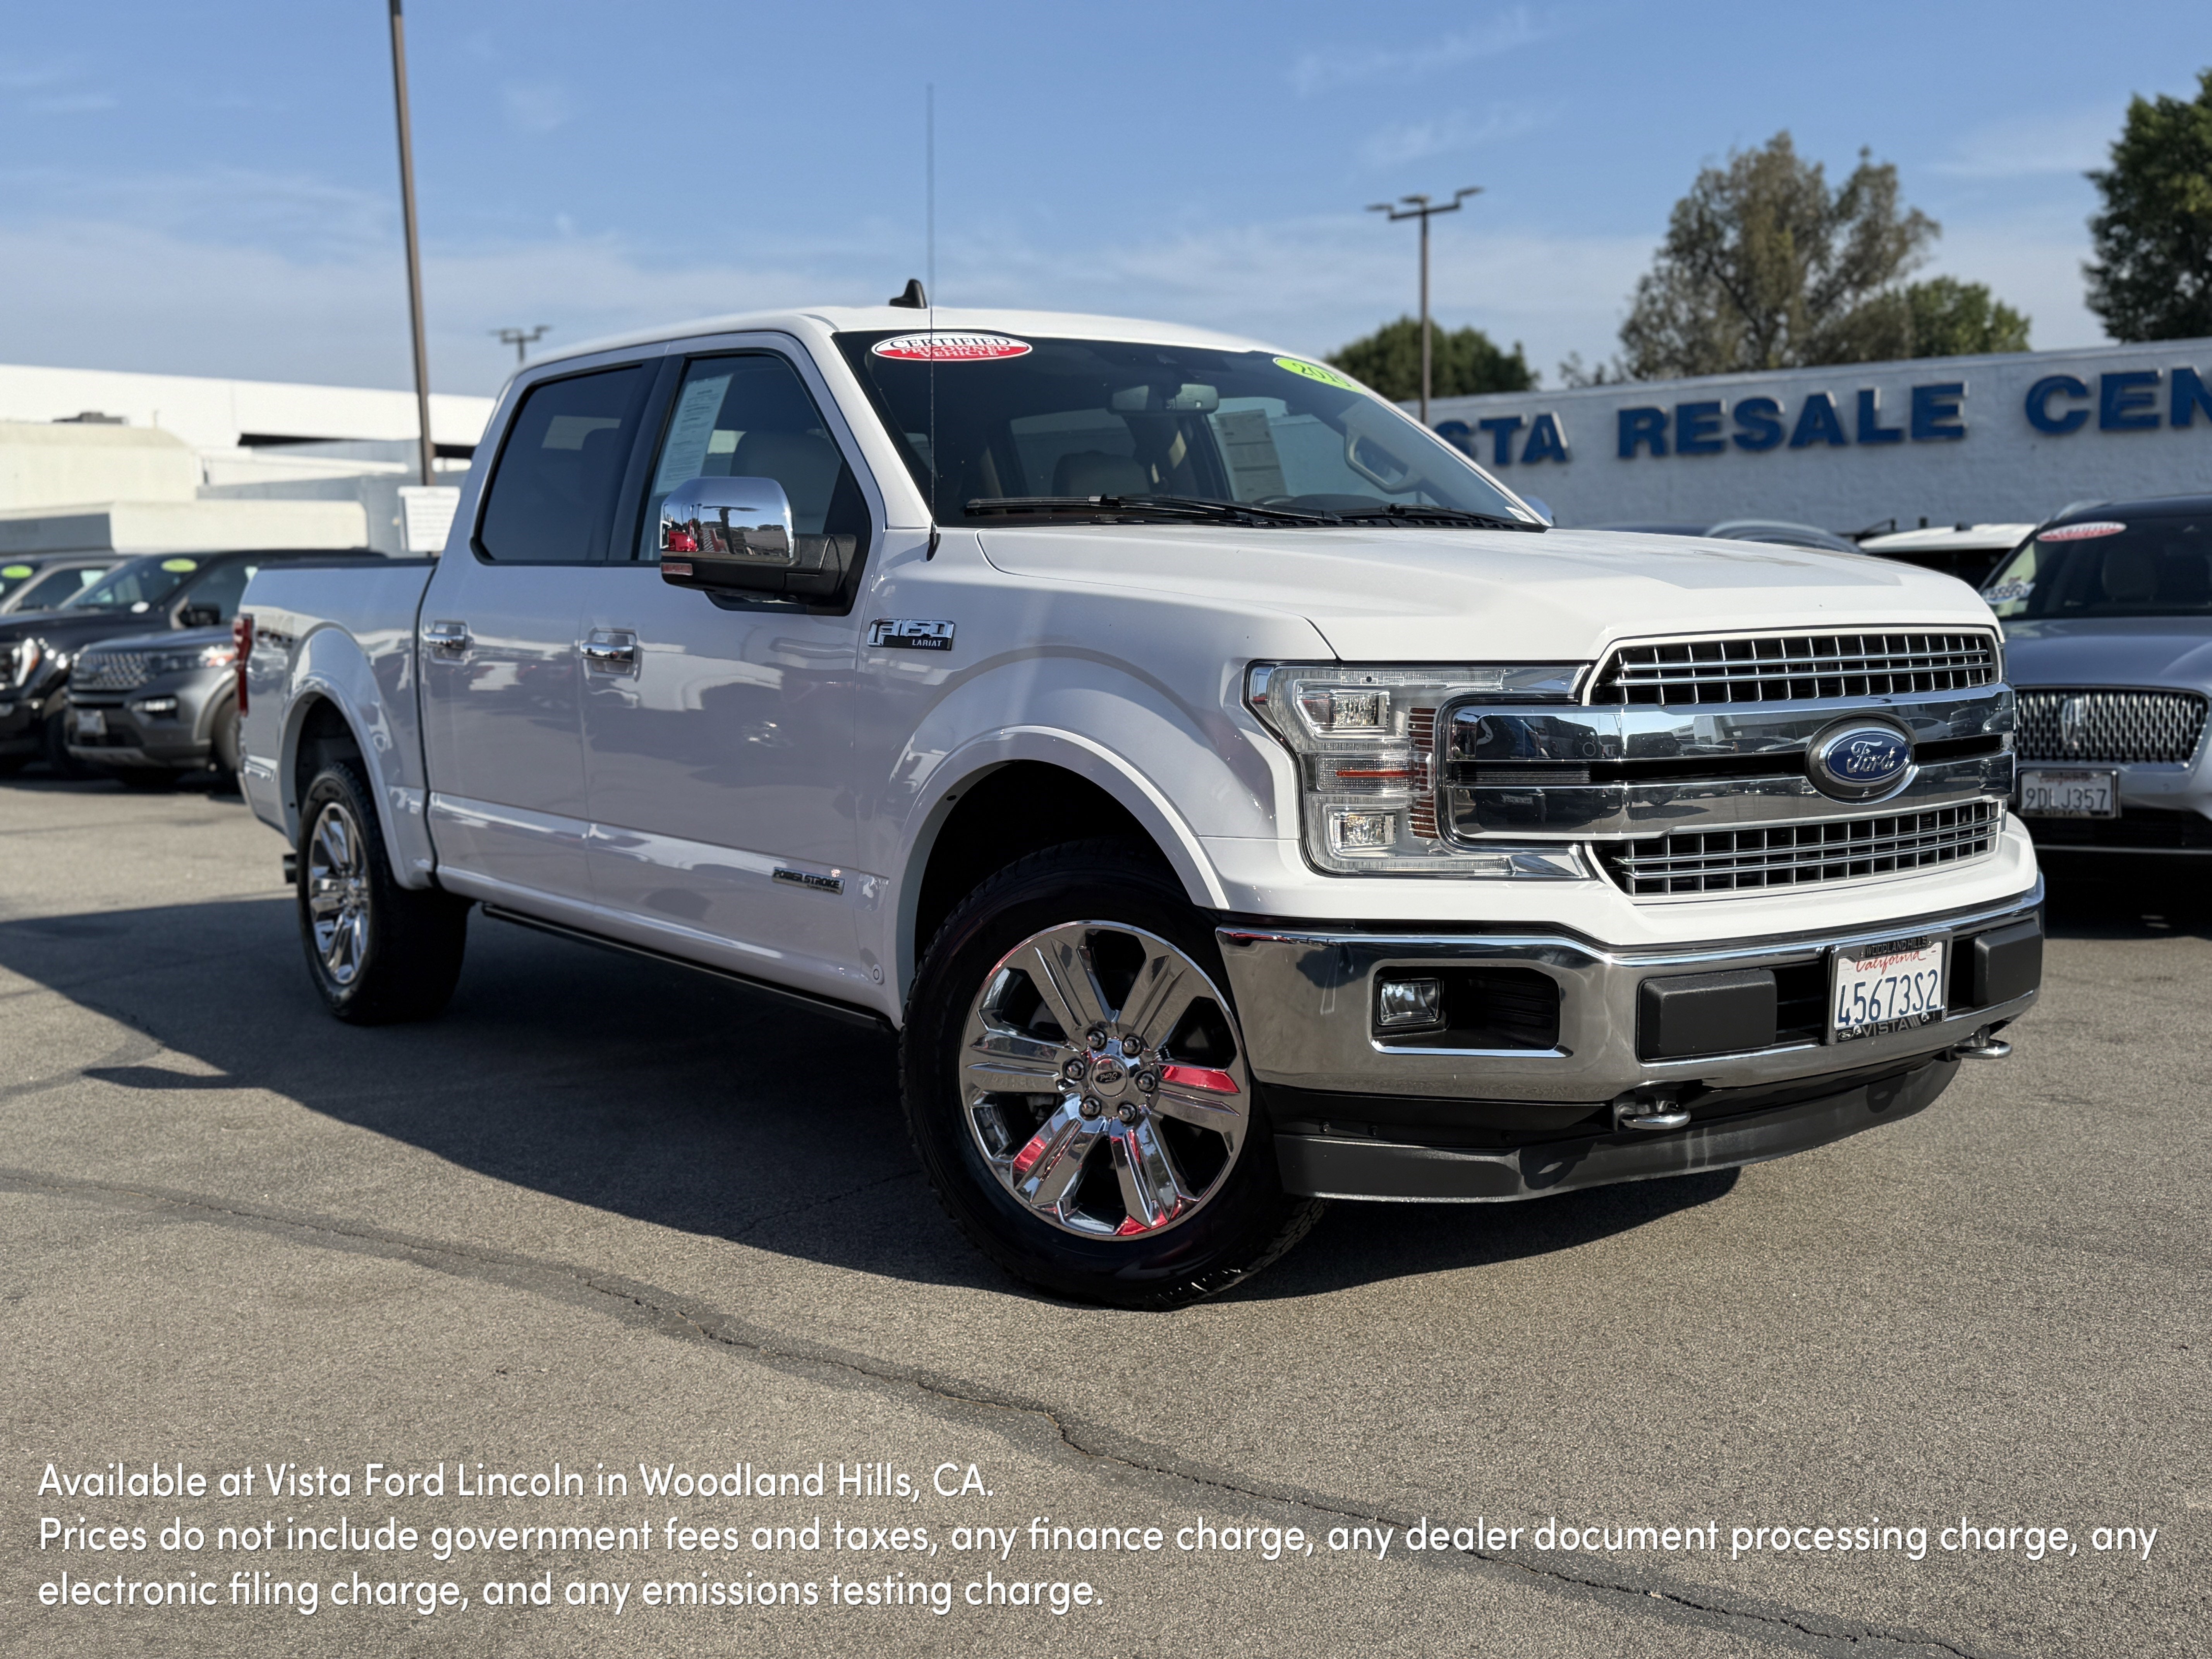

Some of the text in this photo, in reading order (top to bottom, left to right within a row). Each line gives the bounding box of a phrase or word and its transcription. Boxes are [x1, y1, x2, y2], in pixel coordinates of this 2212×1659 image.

[890, 338, 1011, 349] CERTIFIED
[900, 345, 1010, 355] PRE-OWNED
[1617, 381, 1968, 459] RESALE
[912, 639, 943, 647] LARIAT
[1846, 740, 1896, 774] Ford
[2026, 788, 2107, 809] 9DLJ357
[1865, 936, 1928, 957] WOODLAND HILLS
[1838, 969, 1939, 1026] 45673S2
[1861, 1017, 1909, 1038] VISTA
[1099, 1072, 1118, 1082] Ford
